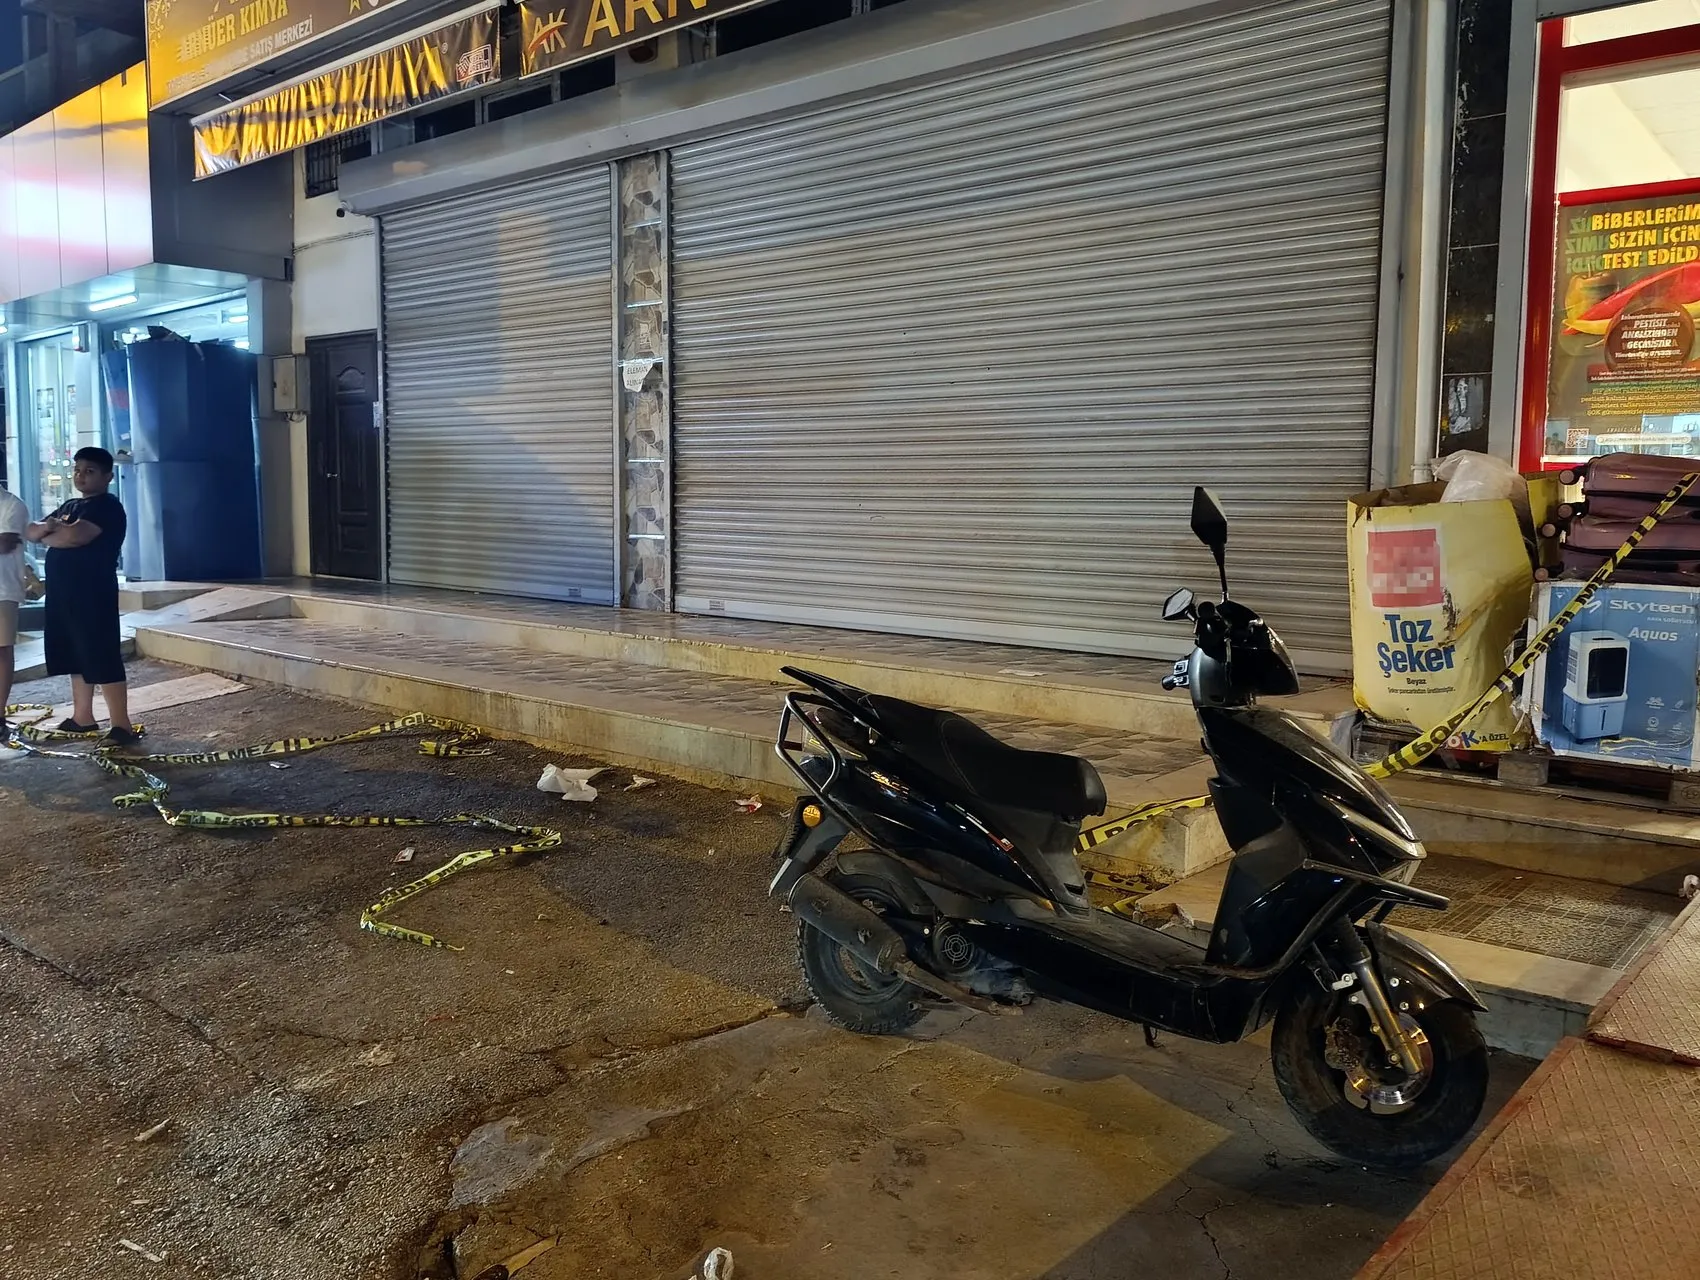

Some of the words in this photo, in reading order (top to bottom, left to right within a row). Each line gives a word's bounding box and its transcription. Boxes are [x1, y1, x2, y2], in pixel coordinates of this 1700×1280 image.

[274, 14, 313, 46] MERKEZİ
[1602, 251, 1641, 270] TEST
[1609, 599, 1696, 614] Skytech
[1384, 613, 1434, 643] Toz
[1627, 627, 1678, 642] Aquos
[1377, 641, 1456, 678] Şeker
[1406, 677, 1427, 686] Beyaz
[1489, 733, 1509, 742] ÖZEL
